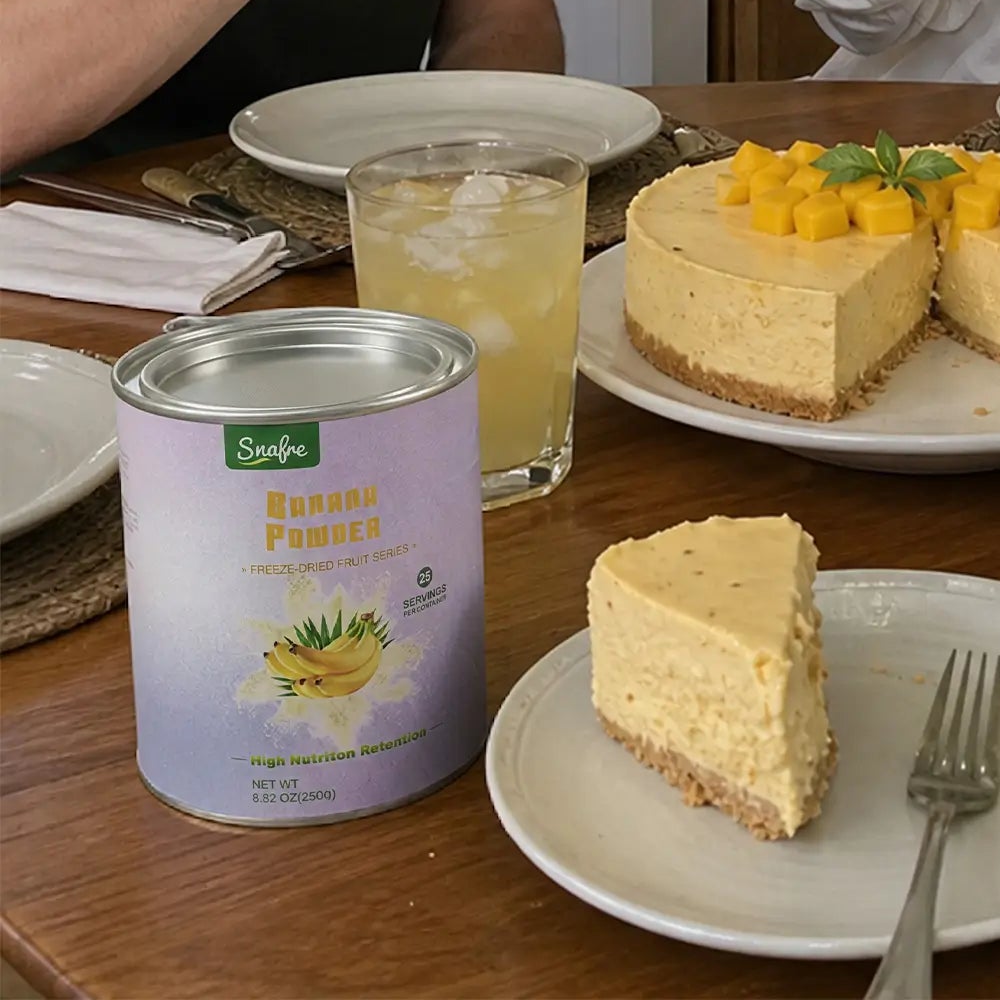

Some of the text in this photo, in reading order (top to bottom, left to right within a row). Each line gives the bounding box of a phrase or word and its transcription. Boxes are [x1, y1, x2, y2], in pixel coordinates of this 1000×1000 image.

[237, 434, 308, 464] Snafre
[251, 544, 409, 575] FREEZE-DRIED FRUIT SERIES
[419, 570, 431, 585] 25
[403, 583, 447, 609] SERVINGS
[251, 755, 285, 768] High
[360, 728, 427, 756] Retention
[252, 778, 299, 790] NET WT
[252, 792, 277, 803] 8.82
